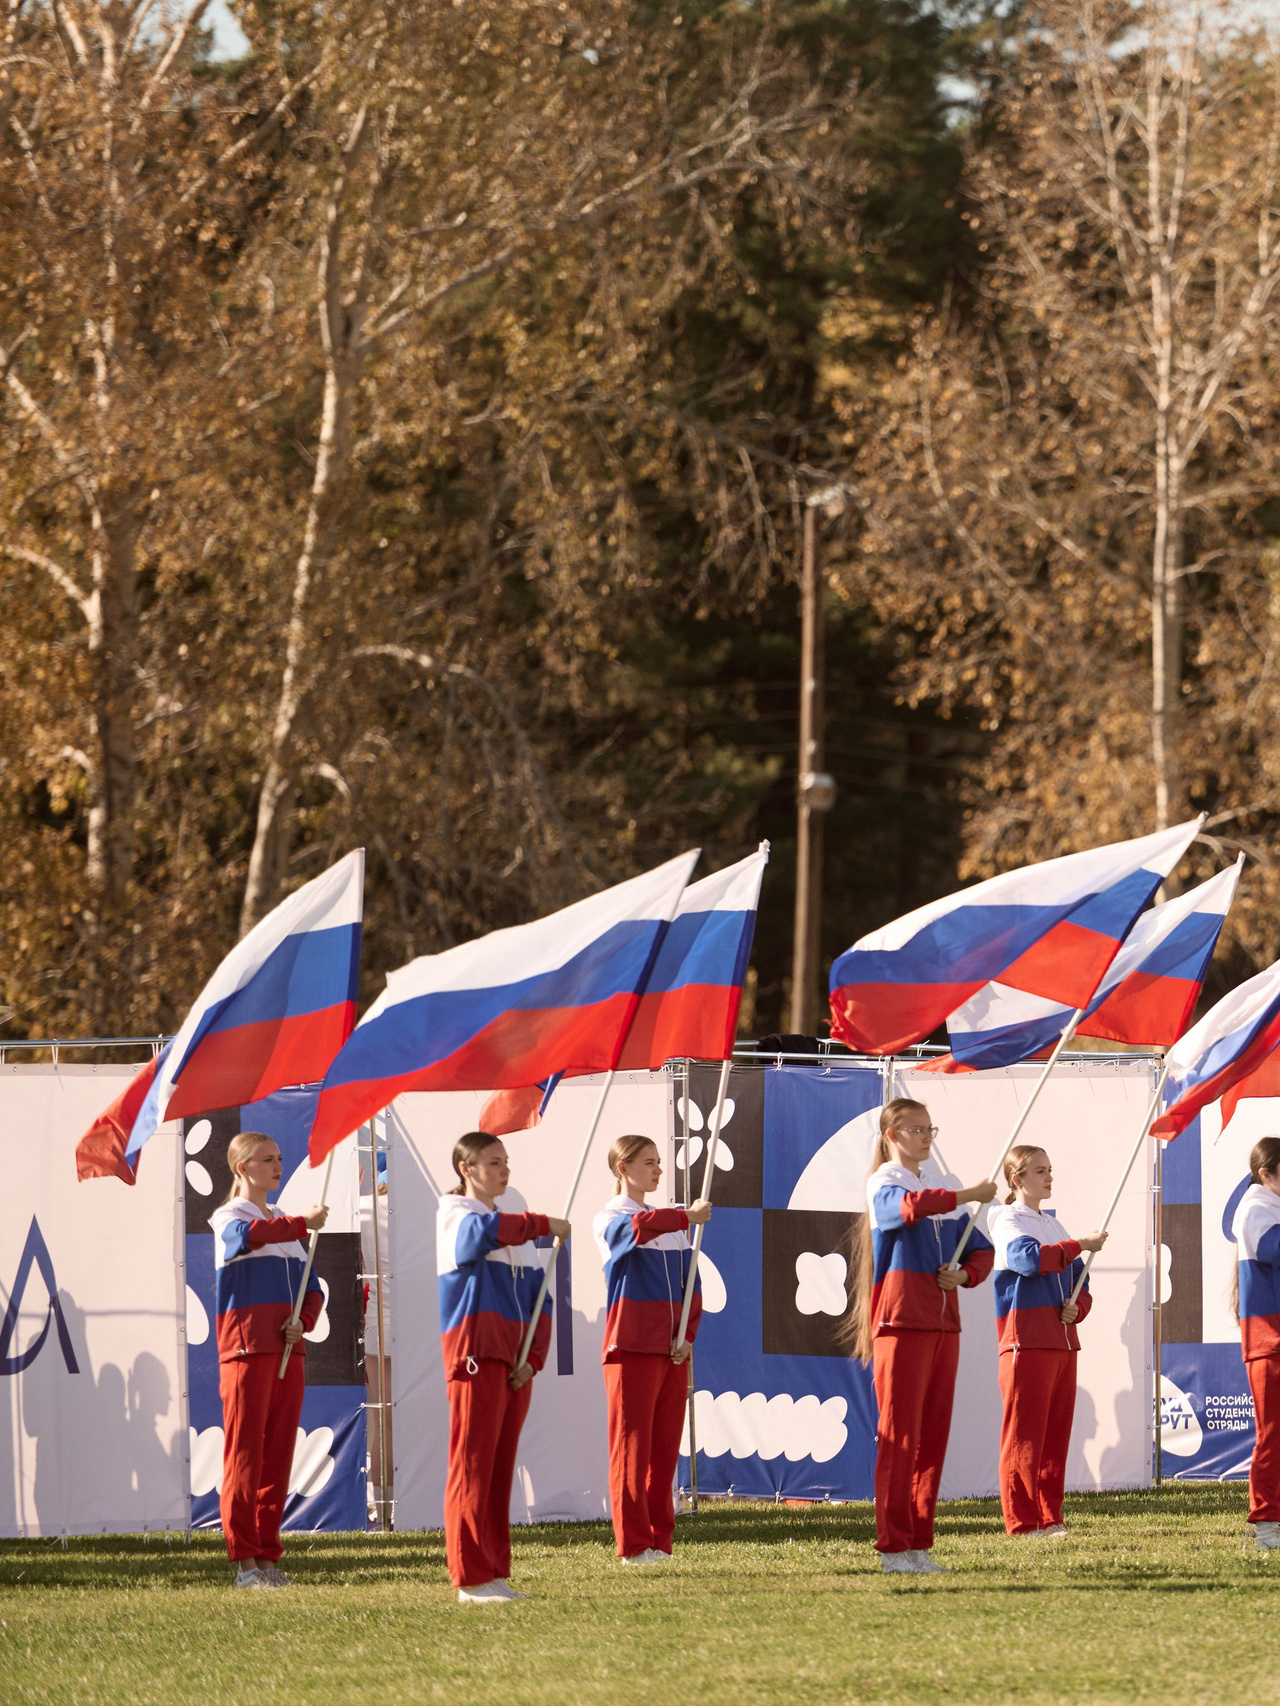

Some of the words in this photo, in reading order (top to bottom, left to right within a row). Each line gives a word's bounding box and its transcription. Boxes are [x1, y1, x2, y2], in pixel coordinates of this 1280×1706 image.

[1205, 1393, 1254, 1406] РОССИЙС
[1205, 1408, 1256, 1419] СТУДЕНЧЕ
[1159, 1414, 1193, 1430] РУТ
[1207, 1420, 1249, 1431] ОТРЯДЫ
